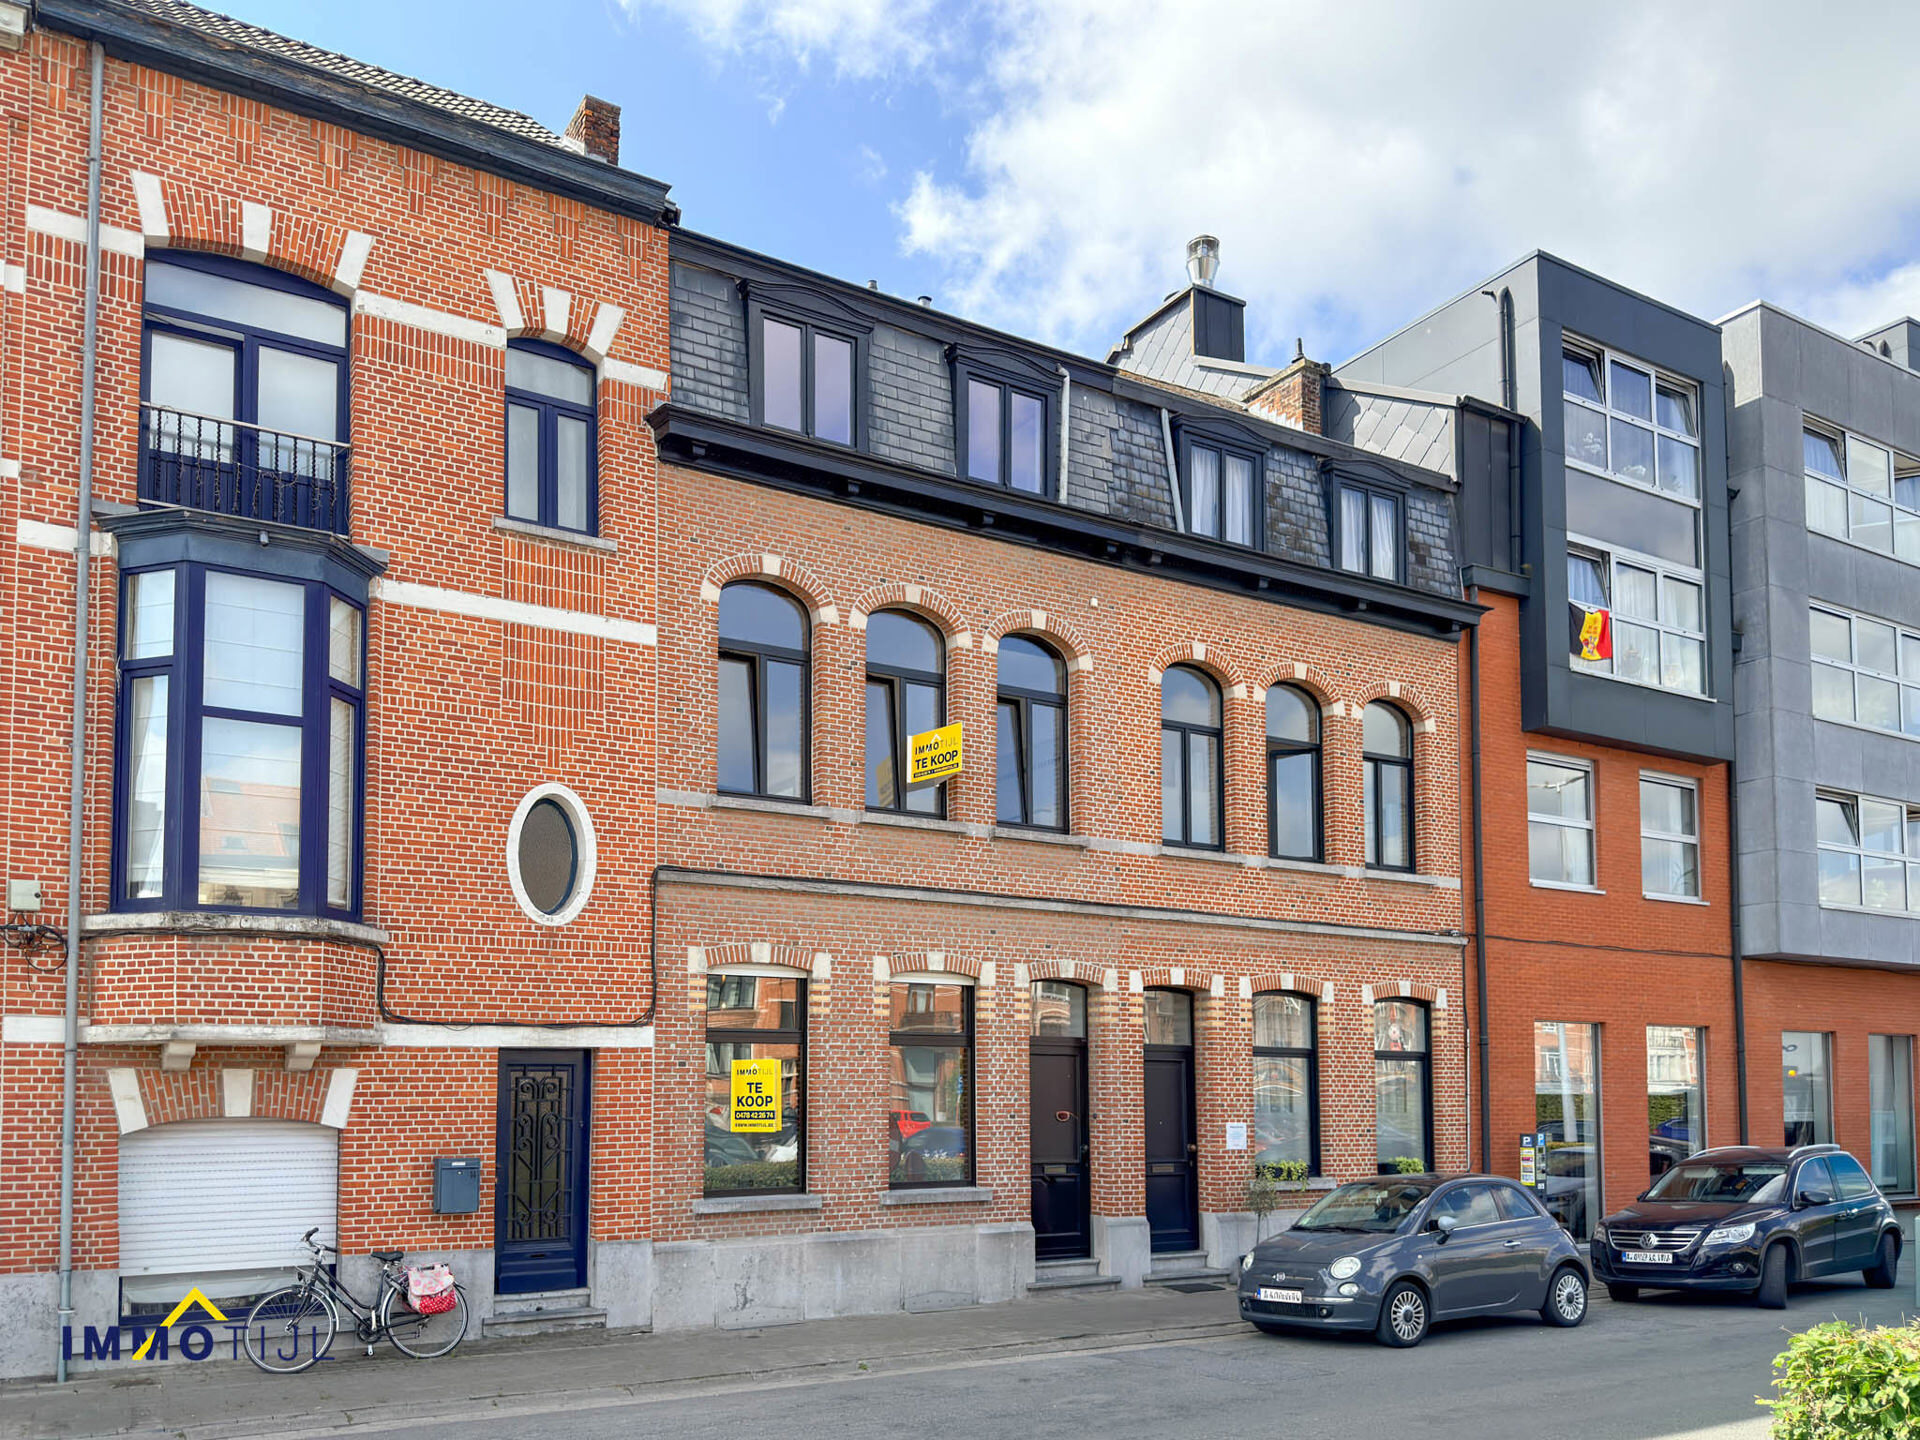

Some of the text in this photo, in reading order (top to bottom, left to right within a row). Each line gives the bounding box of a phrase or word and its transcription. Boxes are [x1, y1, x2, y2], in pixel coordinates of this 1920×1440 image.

[915, 750, 958, 770] TE KOOP
[746, 1082, 763, 1094] TE
[736, 1095, 773, 1107] KOOP
[1522, 1135, 1531, 1145] P
